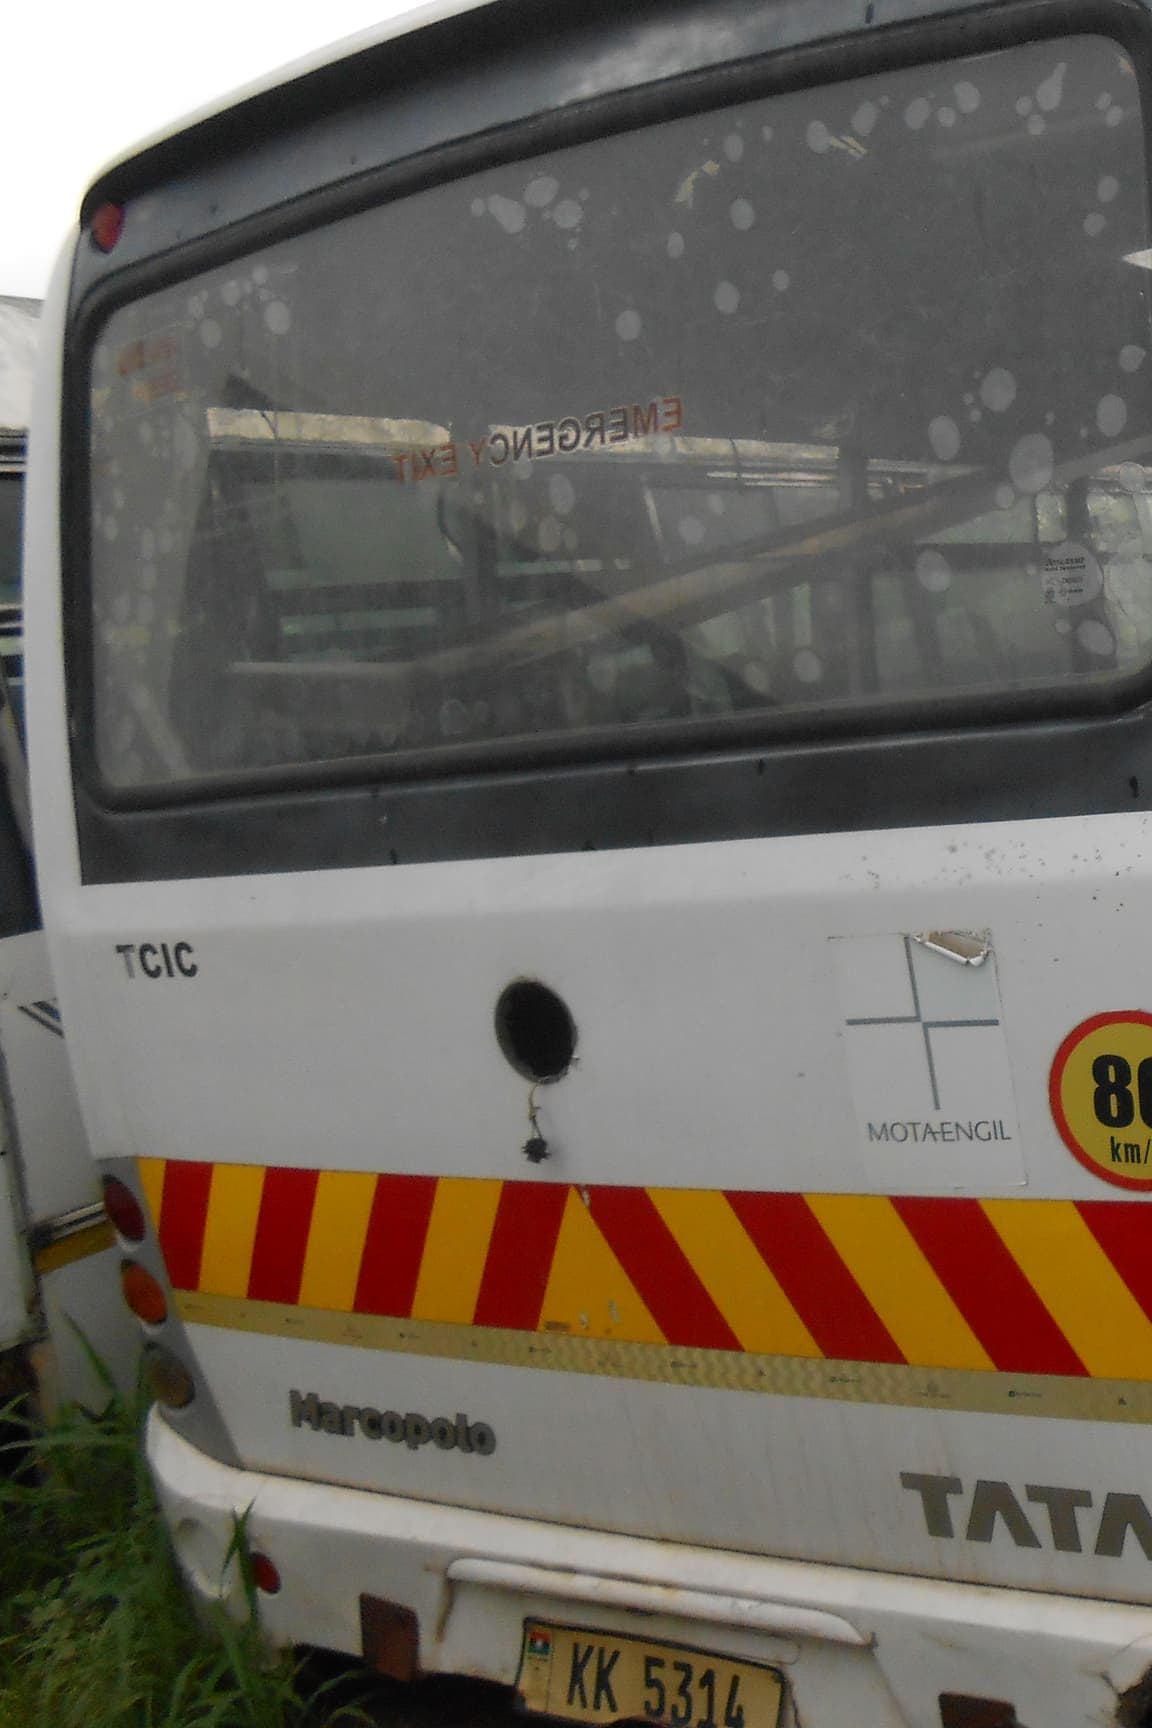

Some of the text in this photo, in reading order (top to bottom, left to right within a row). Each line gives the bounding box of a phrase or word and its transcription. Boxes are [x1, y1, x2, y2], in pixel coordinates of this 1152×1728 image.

[115, 942, 198, 979] TCIC
[289, 1388, 497, 1457] Marcopolo
[567, 1642, 745, 1728] KK 5314
